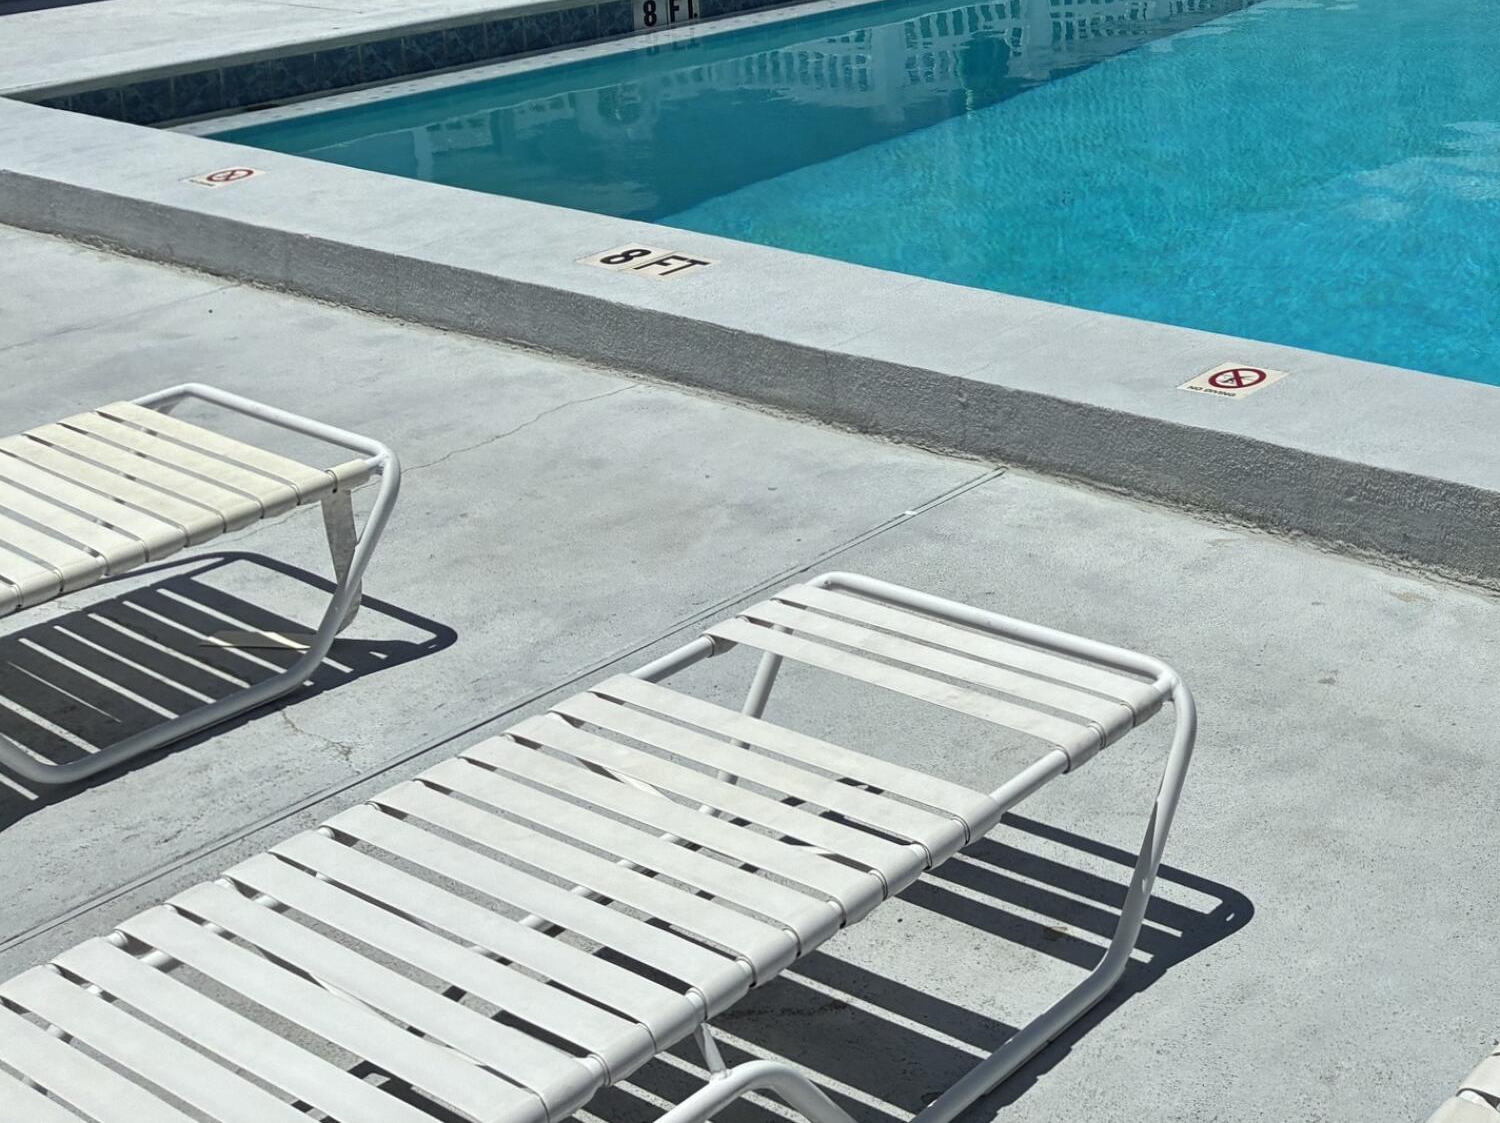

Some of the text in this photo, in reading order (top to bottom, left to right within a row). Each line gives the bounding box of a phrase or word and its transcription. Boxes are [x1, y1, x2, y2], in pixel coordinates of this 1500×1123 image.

[643, 0, 657, 27] 8
[600, 248, 710, 276] 8 FT
